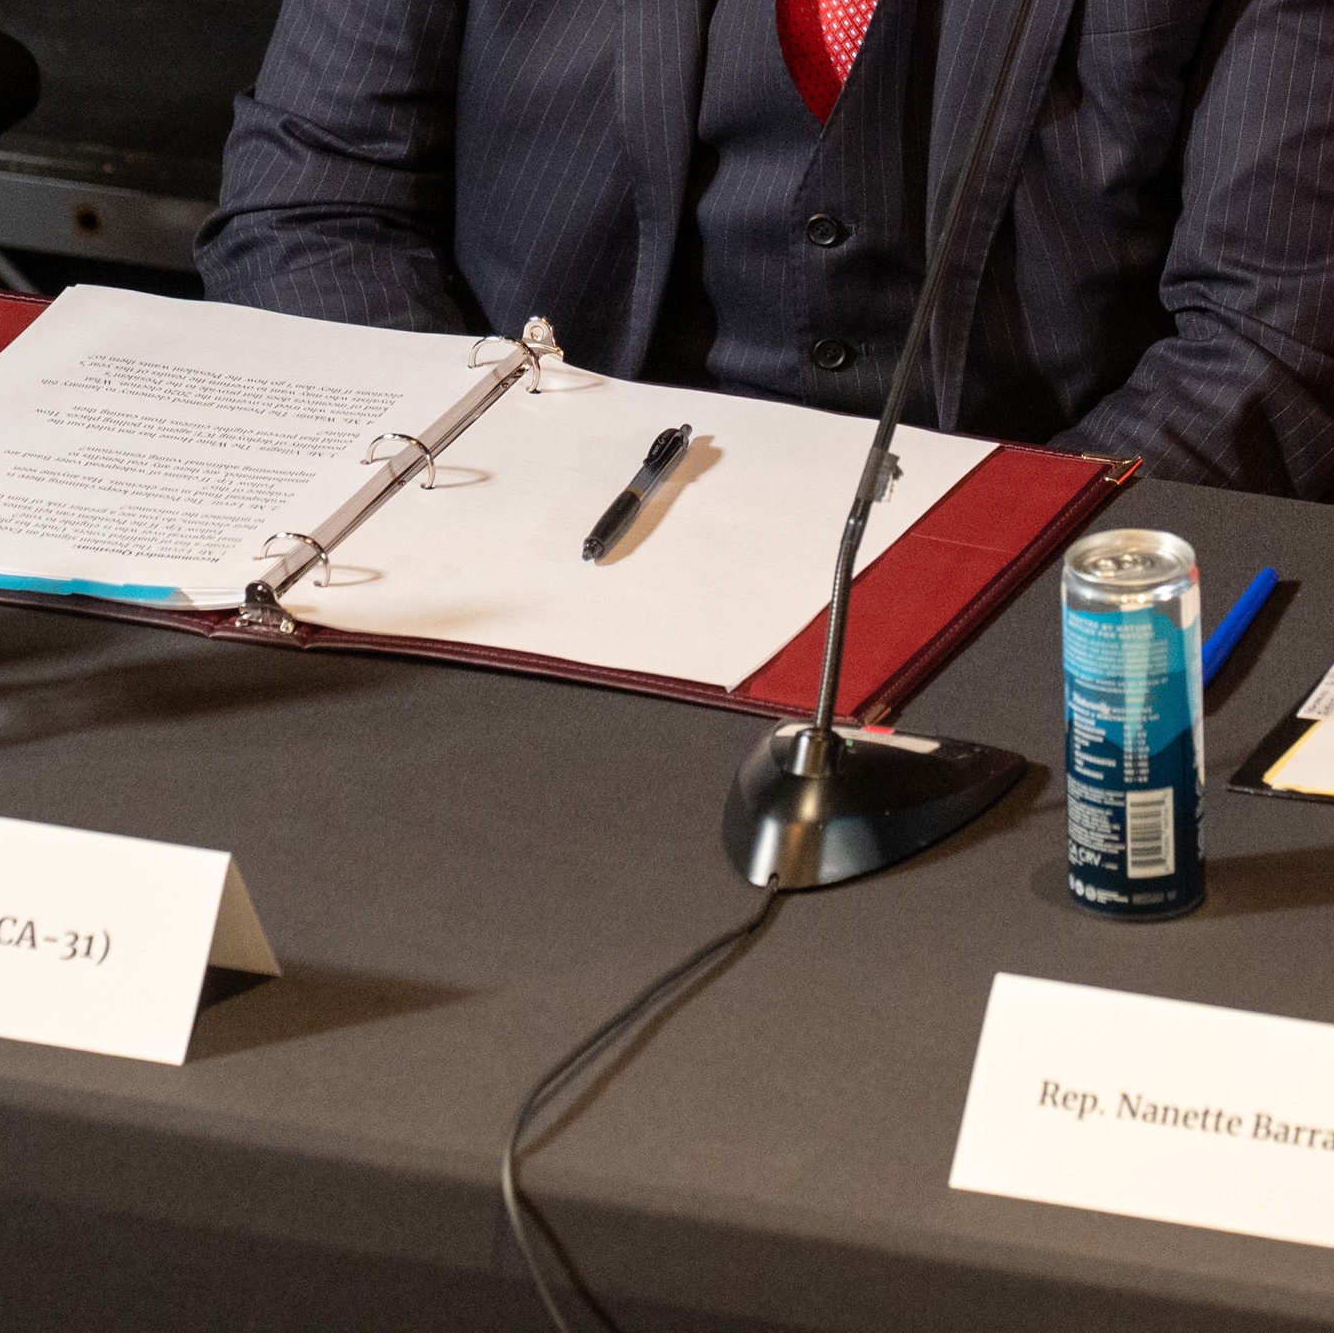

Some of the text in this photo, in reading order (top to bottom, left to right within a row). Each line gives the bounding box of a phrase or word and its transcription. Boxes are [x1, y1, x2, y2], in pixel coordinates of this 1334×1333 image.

[135, 551, 219, 563] Recommended
[1037, 1080, 1105, 1121] Rep.
[1116, 1091, 1244, 1137] Nanette
